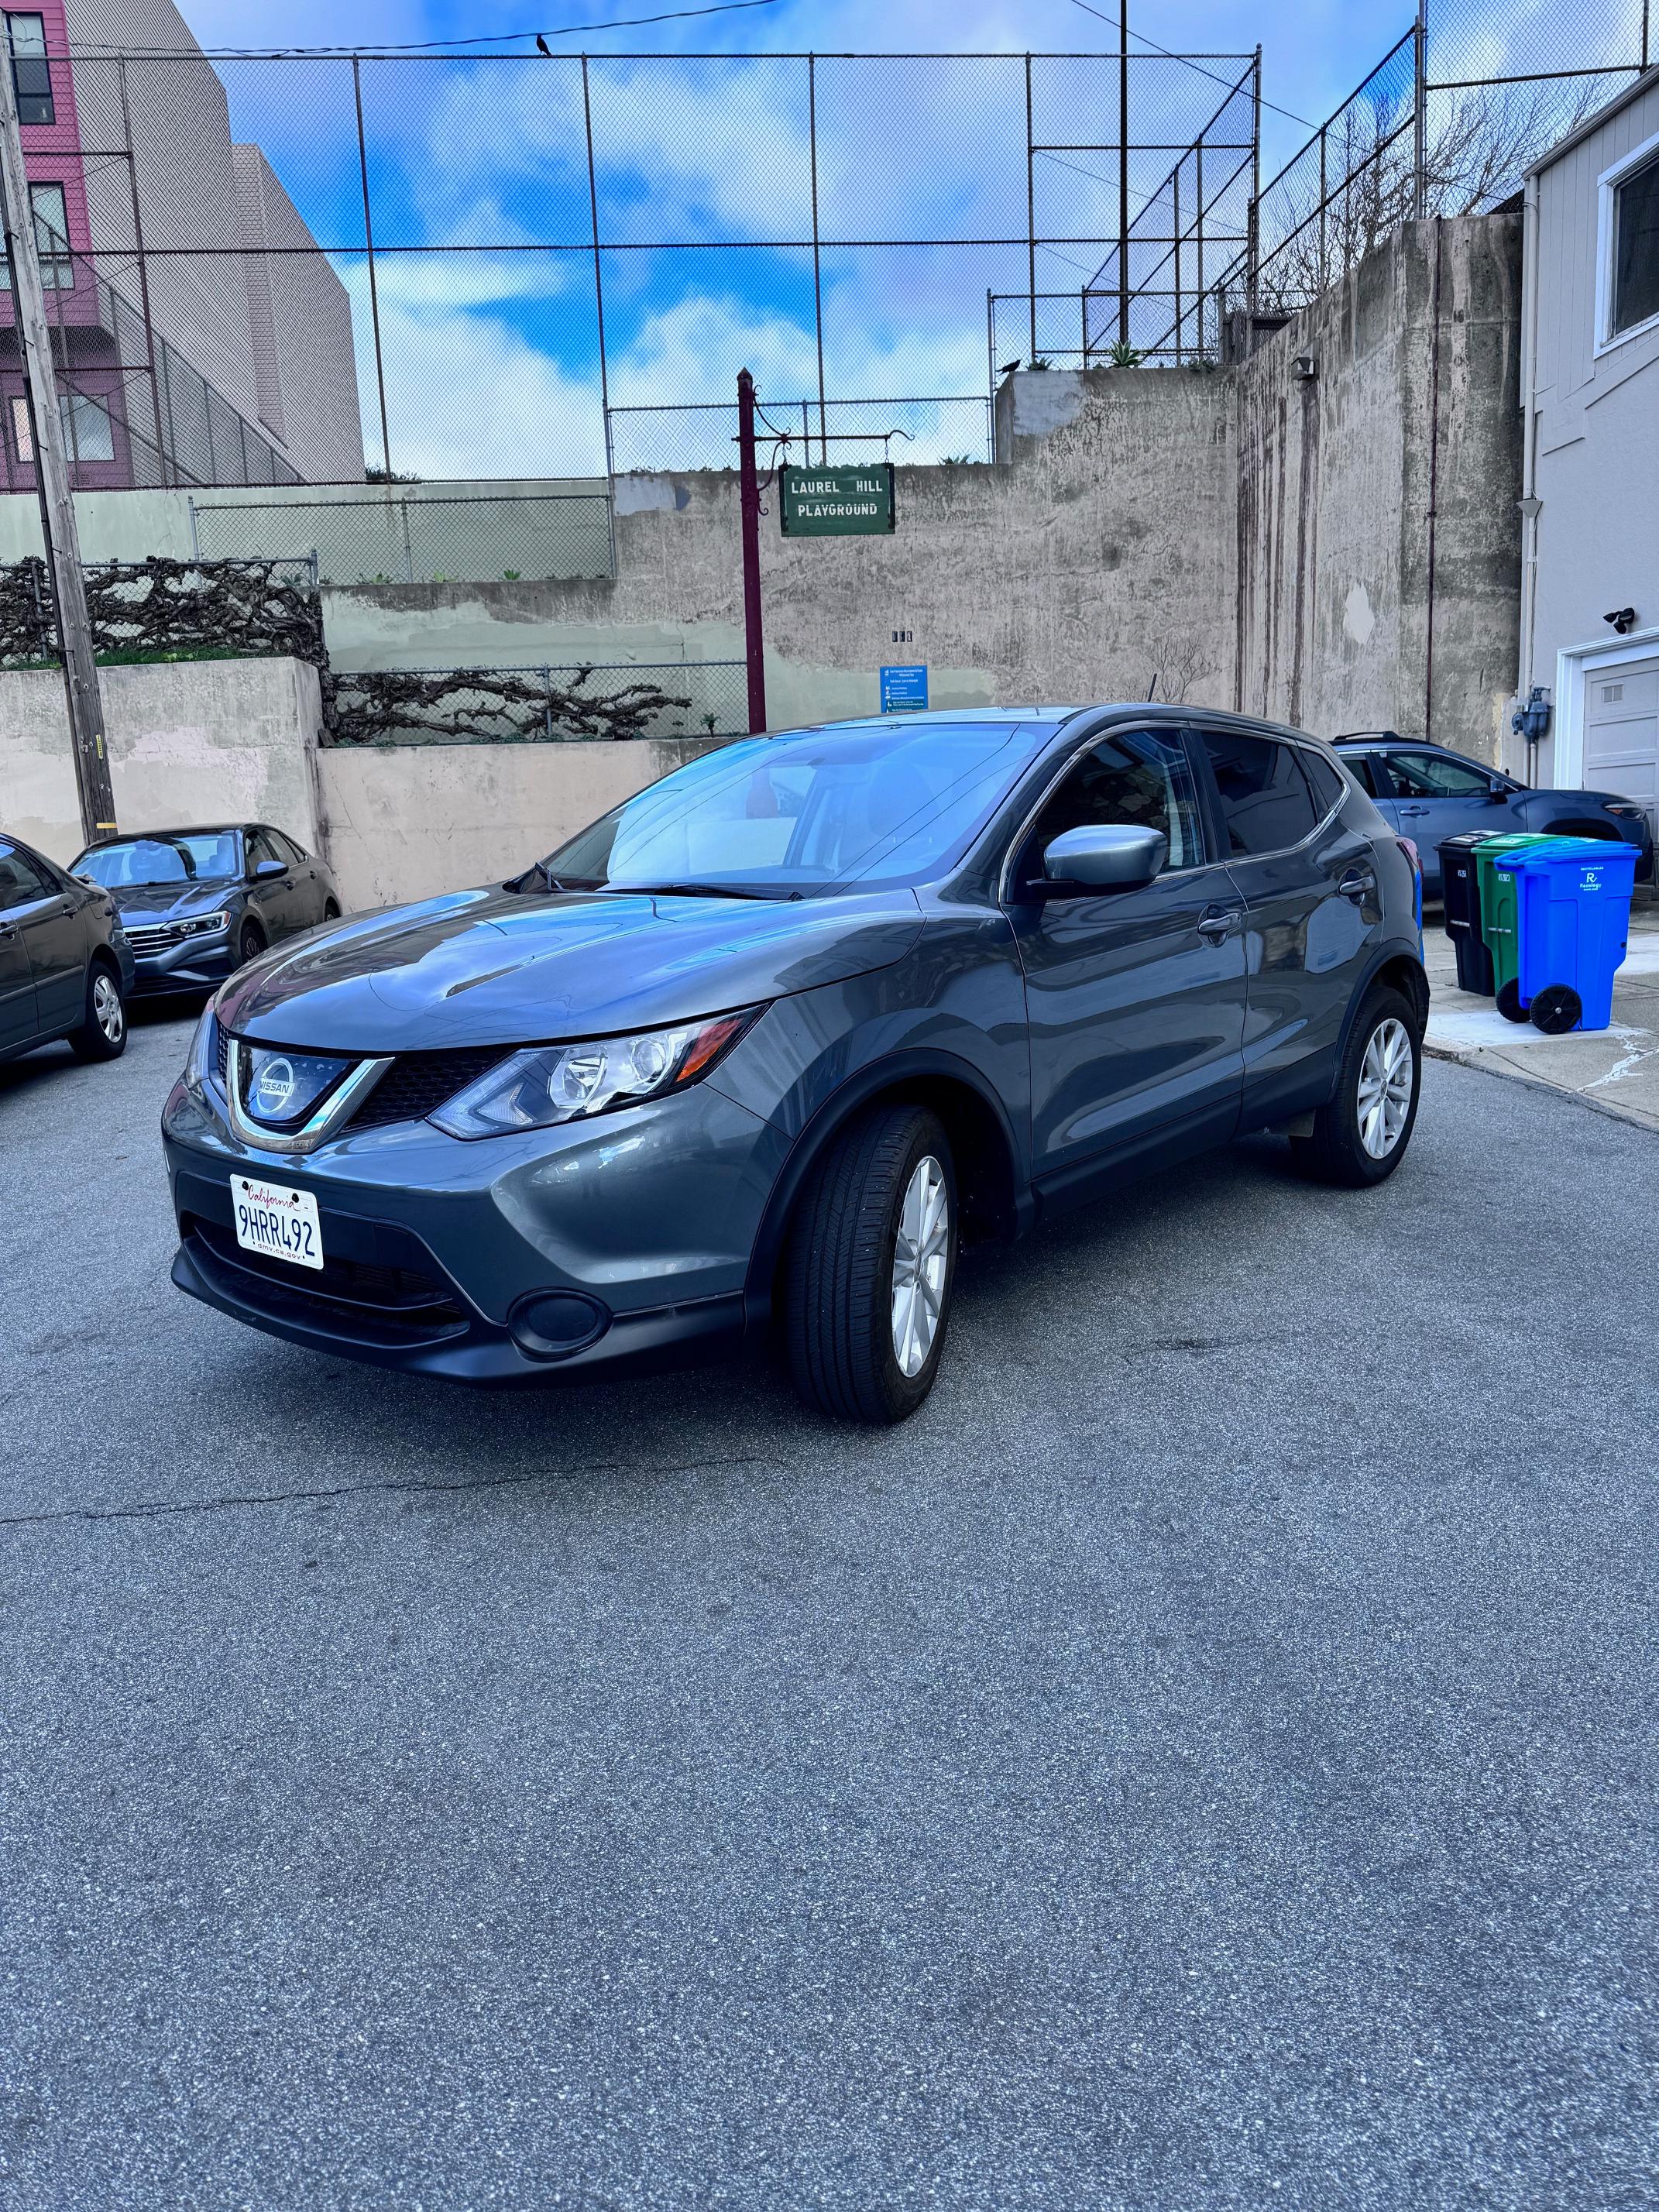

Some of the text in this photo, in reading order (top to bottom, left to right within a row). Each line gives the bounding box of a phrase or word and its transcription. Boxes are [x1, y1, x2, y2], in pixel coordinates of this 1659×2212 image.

[792, 480, 883, 493] LAUREL HILL
[798, 503, 878, 517] PLAYGROUND
[259, 1080, 290, 1094] NISSAN
[248, 1184, 301, 1211] California
[239, 1204, 315, 1257] 9HRR492
[257, 1242, 301, 1259] dmv.ca.gov
